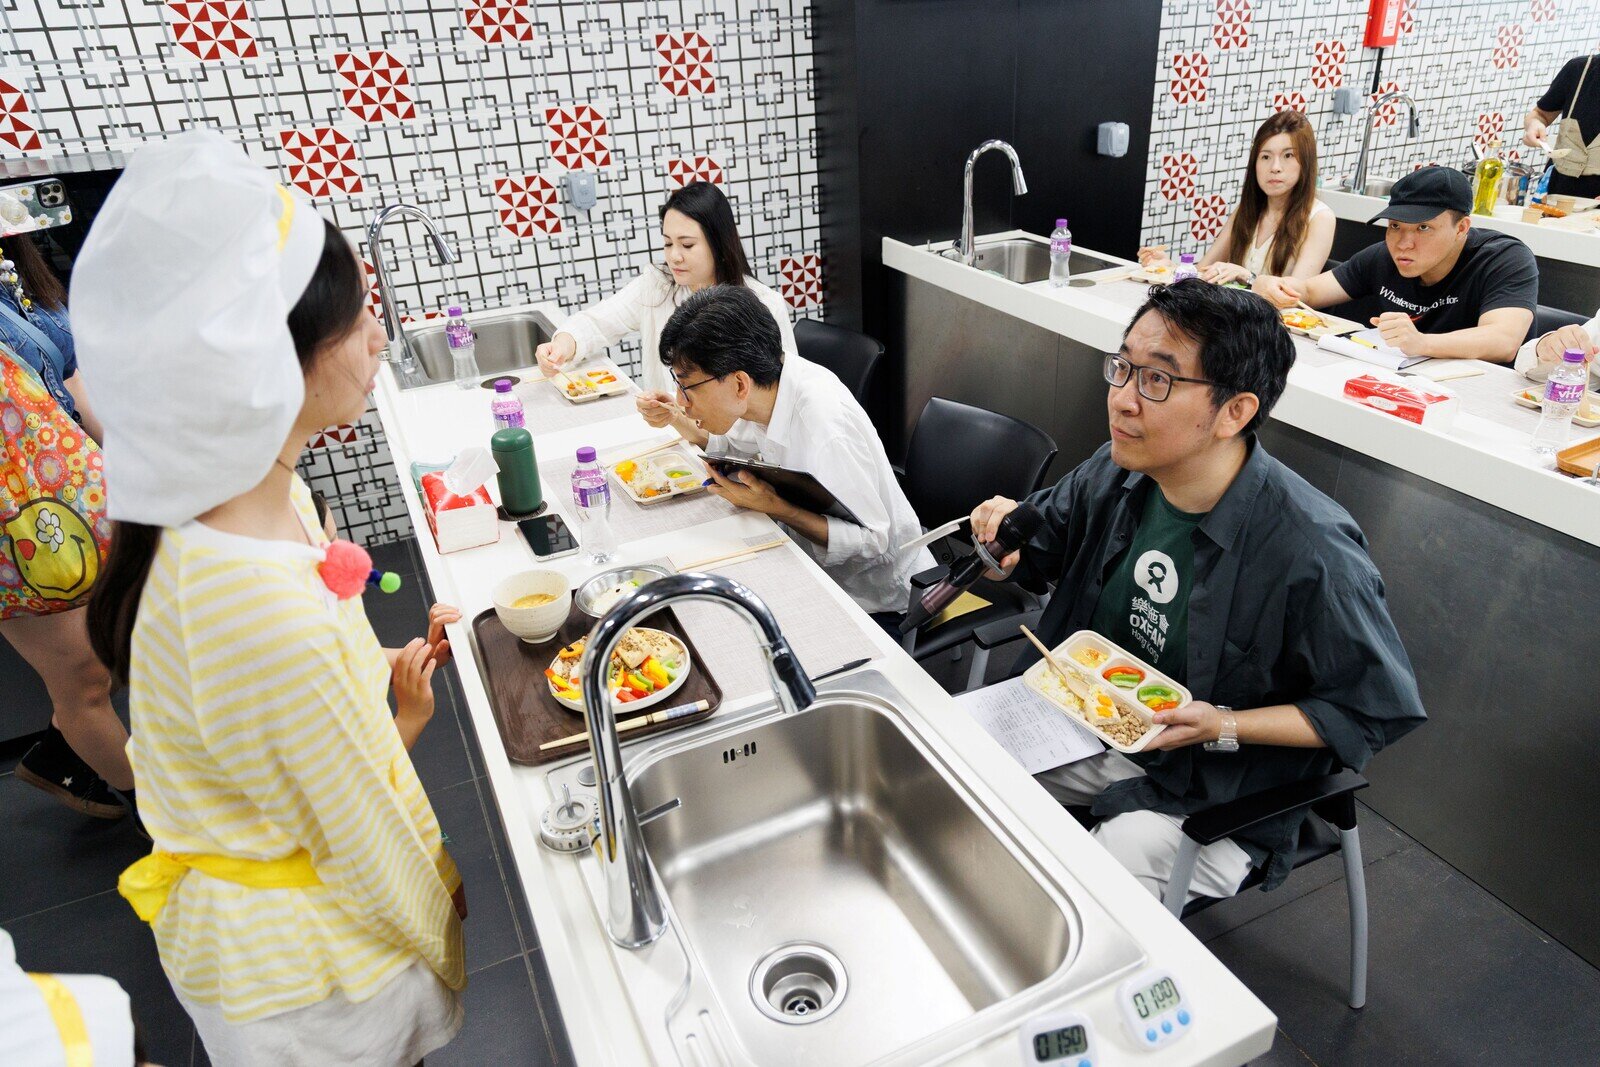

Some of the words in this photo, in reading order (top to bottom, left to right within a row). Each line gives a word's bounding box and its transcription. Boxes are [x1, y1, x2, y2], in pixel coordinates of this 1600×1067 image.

[1380, 286, 1418, 311] Whatever
[1416, 305, 1430, 315] yo
[1129, 613, 1166, 652] OXFAM
[1131, 628, 1147, 649] Hong
[1146, 642, 1159, 664] Kong
